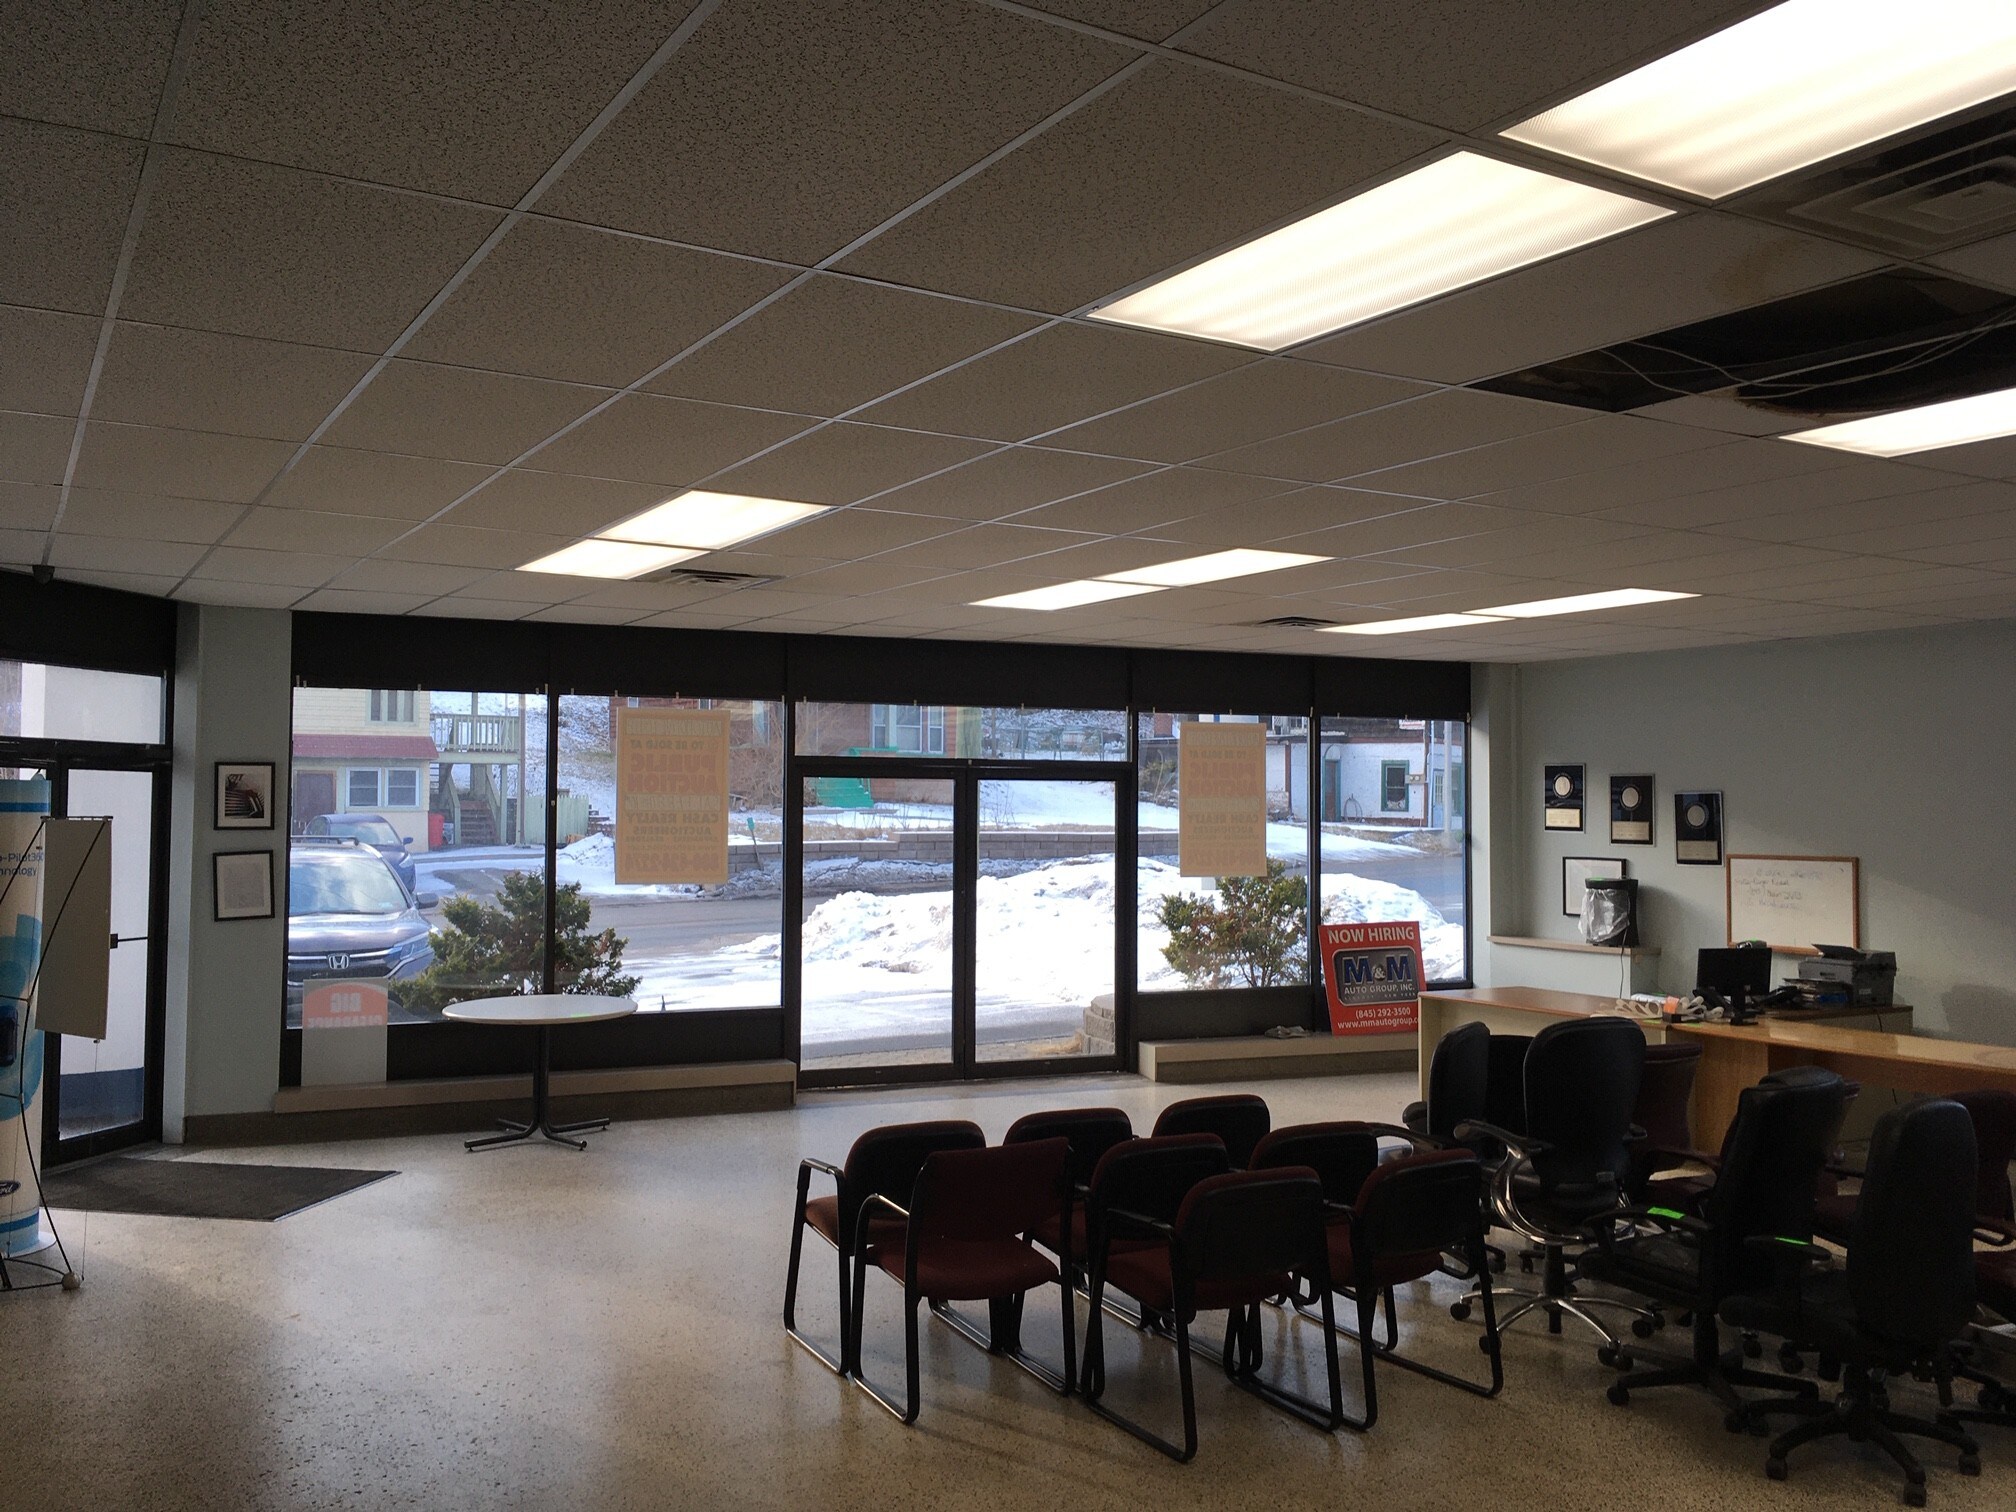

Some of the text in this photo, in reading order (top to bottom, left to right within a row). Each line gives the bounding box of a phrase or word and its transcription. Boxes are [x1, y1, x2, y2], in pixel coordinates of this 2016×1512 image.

[1327, 926, 1415, 944] NOW HIRING
[1342, 953, 1413, 986] M&M
[1344, 983, 1415, 995] AUTO GROUP, INC.
[1355, 1007, 1411, 1020] (845) 292-3500
[1337, 1016, 1418, 1029] www.mmautogroup.c
